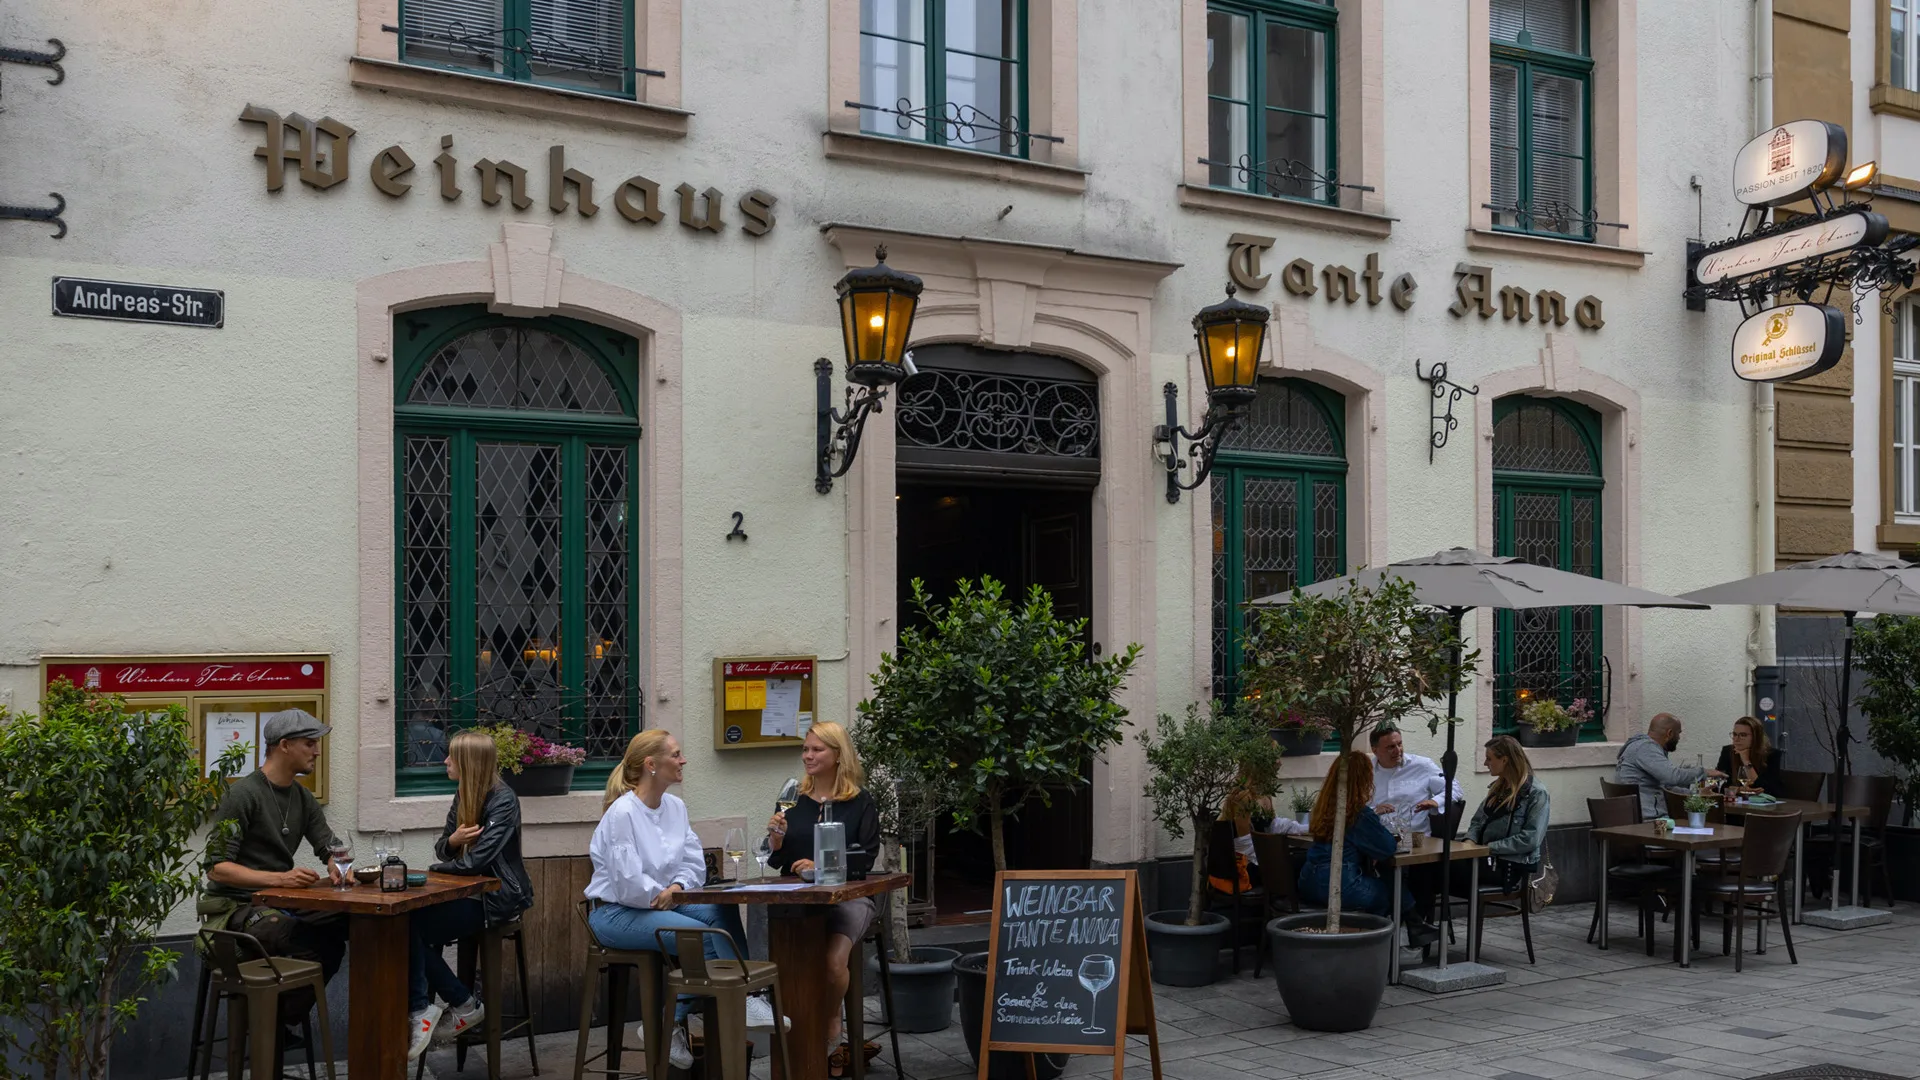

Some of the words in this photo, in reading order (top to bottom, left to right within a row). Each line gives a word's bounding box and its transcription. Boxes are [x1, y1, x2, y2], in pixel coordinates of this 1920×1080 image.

[238, 103, 778, 237] Weinhaus
[1736, 178, 1776, 197] PASSION
[1779, 171, 1798, 184] SEIT
[1802, 163, 1824, 177] 1820
[1227, 233, 1419, 311] Tante
[1448, 262, 1606, 330] Anna
[72, 285, 204, 318] Andreas-Str.
[1740, 350, 1776, 365] Original
[1779, 342, 1816, 359] Schlüssel
[726, 511, 748, 541] 2
[116, 666, 190, 685] Weinhaus
[194, 664, 243, 687] Tante
[246, 668, 292, 683] Anna
[1005, 884, 1115, 918] WEINBAR
[1003, 918, 1067, 951] TANTE
[1066, 916, 1120, 946] ANNA
[1003, 957, 1041, 976] Trink
[1041, 958, 1073, 977] Wein
[997, 992, 1048, 1011] Genieße
[1054, 997, 1079, 1010] den
[1031, 981, 1048, 998] &
[996, 1008, 1085, 1026] Sonnenschein
